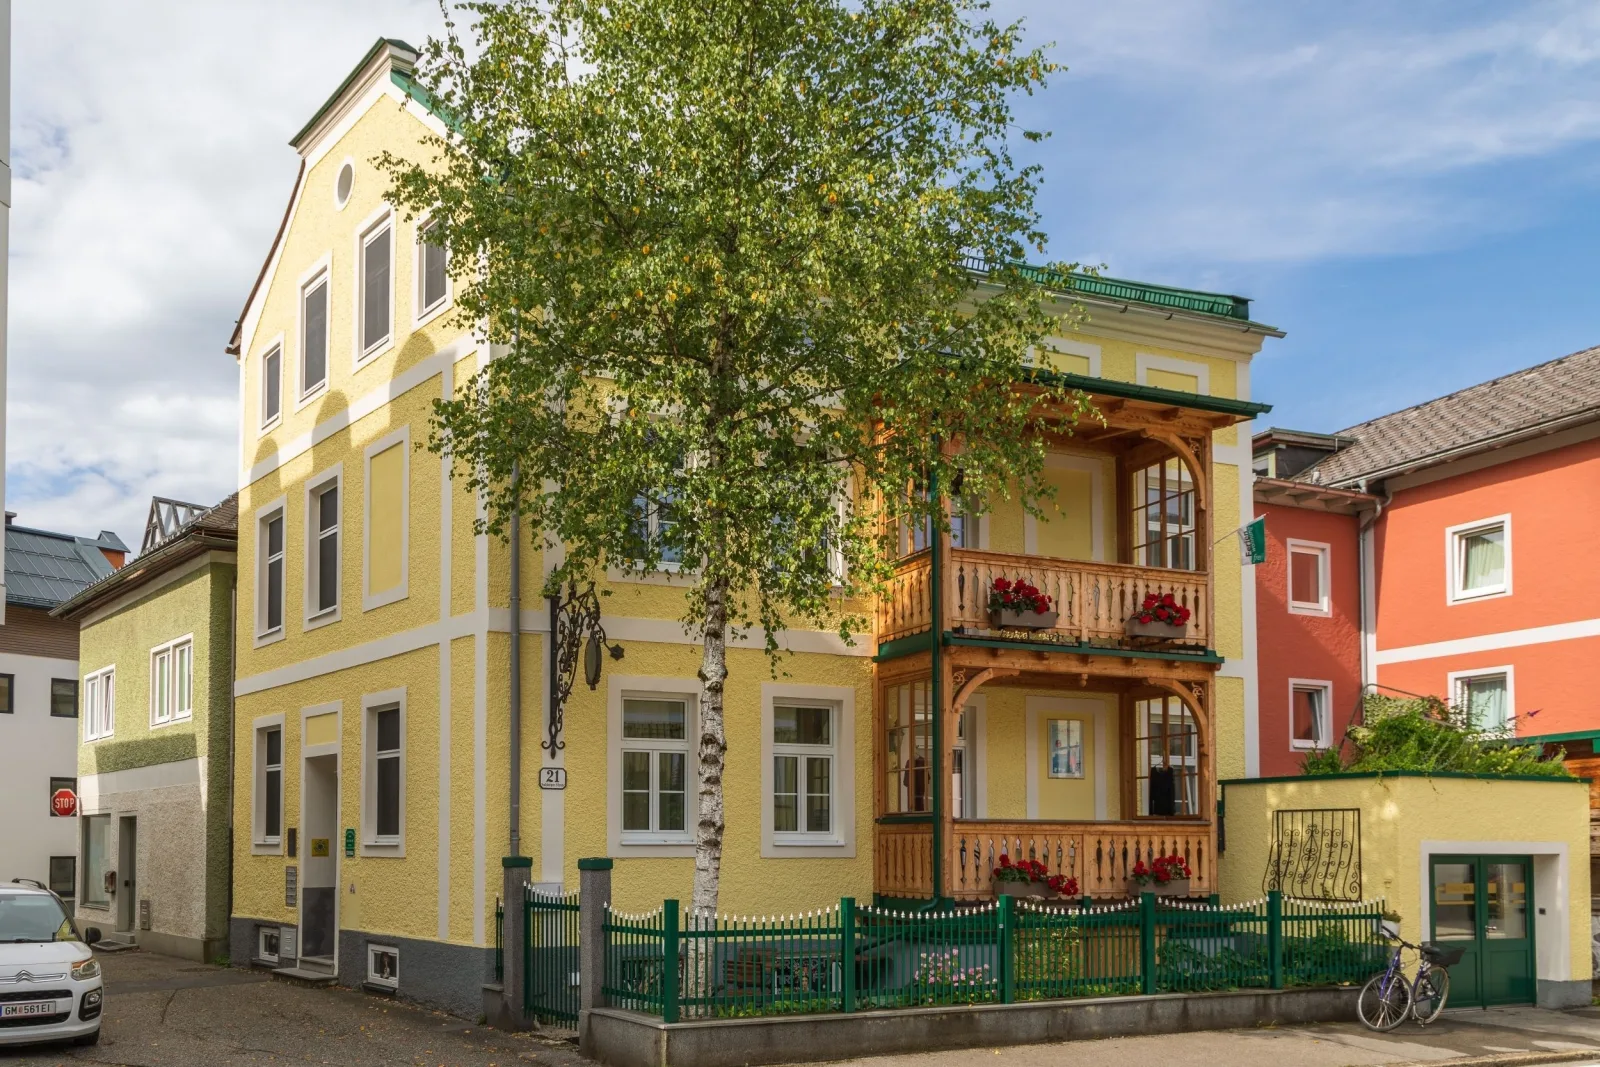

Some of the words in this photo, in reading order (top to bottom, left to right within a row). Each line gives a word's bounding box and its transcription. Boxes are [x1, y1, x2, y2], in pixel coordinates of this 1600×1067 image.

[1244, 530, 1252, 556] Ferien
[546, 770, 560, 782] 21
[55, 798, 74, 808] STOP
[5, 1006, 17, 1015] GM
